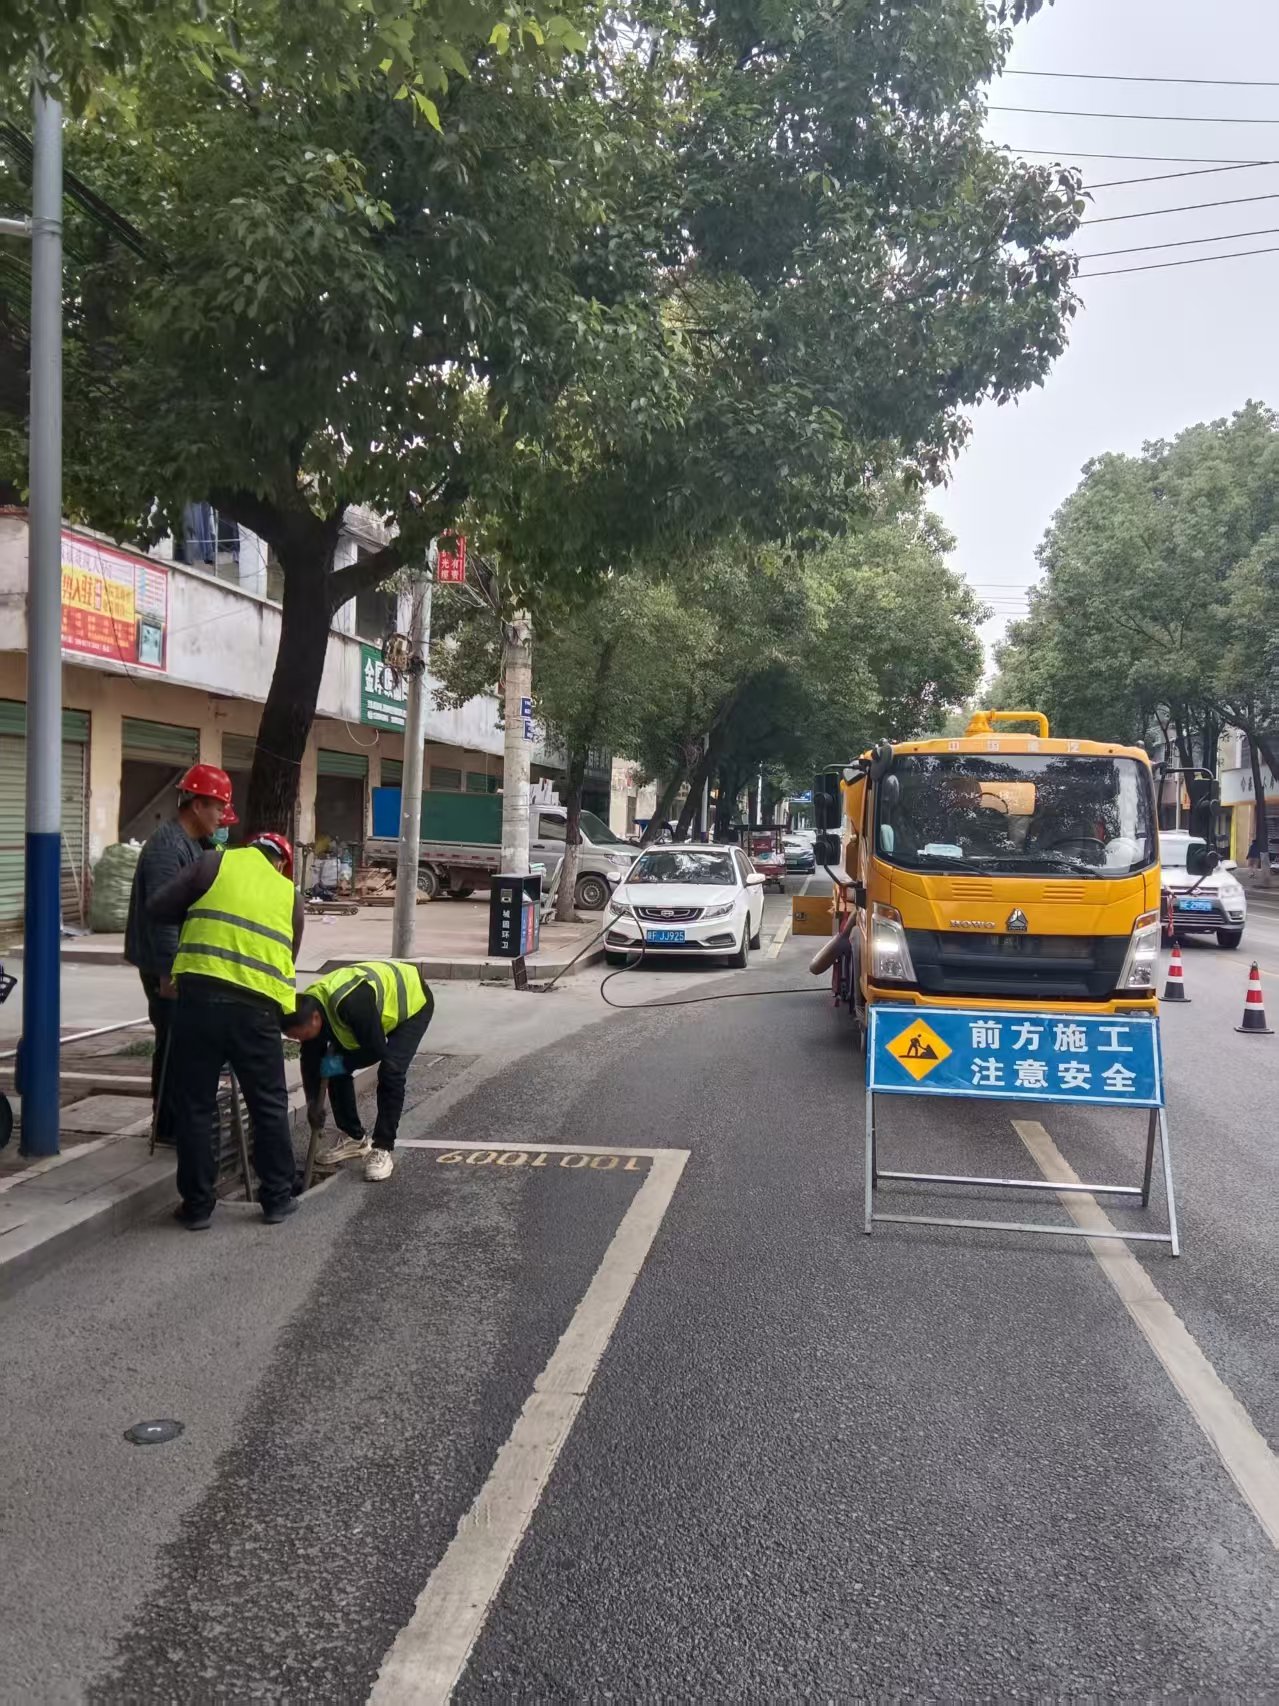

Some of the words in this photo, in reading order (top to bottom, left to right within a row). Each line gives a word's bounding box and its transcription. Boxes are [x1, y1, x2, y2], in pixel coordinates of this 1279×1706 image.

[950, 919, 996, 929] HOWO
[968, 1020, 1134, 1053] 前方施工
[970, 1057, 1138, 1092] 注意安全
